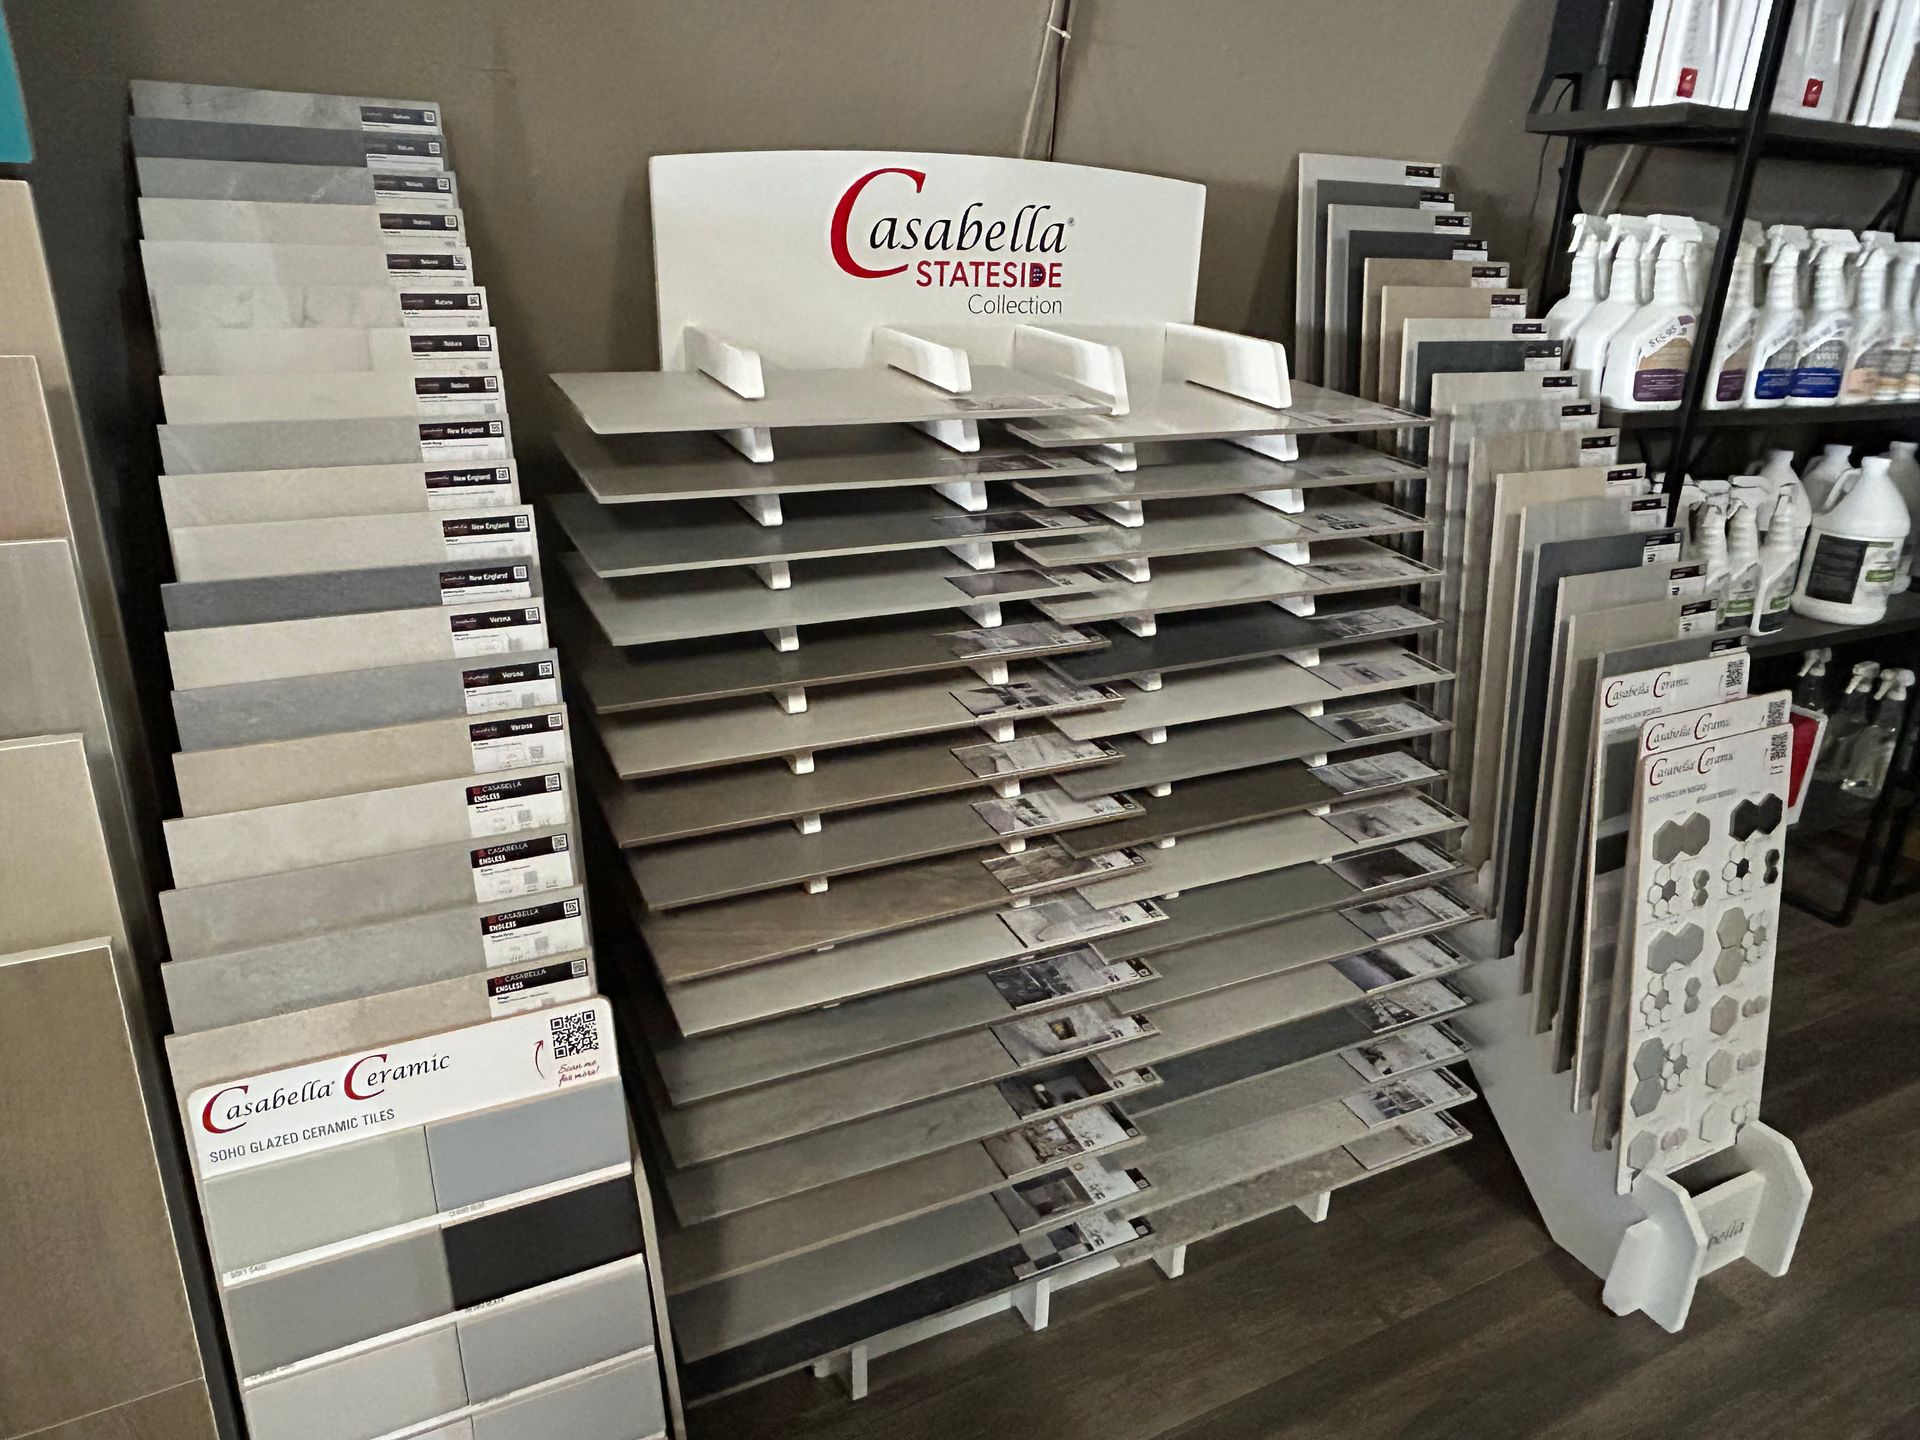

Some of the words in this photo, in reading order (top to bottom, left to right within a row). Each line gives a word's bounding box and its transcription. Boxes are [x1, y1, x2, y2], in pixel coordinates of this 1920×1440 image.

[830, 167, 1067, 279] Casabella
[916, 260, 1062, 289] STATESIDE
[968, 293, 1062, 315] Collection
[447, 427, 460, 435] New
[461, 426, 484, 436] England
[485, 521, 510, 531] England
[501, 670, 524, 679] Verona
[482, 781, 522, 793] CASABELLA
[474, 792, 501, 803] ENDLESS
[487, 843, 528, 855] CASABELLA
[479, 854, 506, 865] ENDLESS
[498, 908, 539, 921] CASABELLA
[489, 920, 517, 932] ENDLESS
[504, 968, 547, 982] CASABELLA
[495, 981, 524, 993] ENDLESS
[202, 1079, 334, 1133] Casabella
[343, 1053, 450, 1100] Ceramic
[209, 1144, 246, 1163] SOHO
[250, 1132, 299, 1154] GLAZED
[302, 1117, 359, 1140] CERAMIC
[362, 1108, 395, 1127] TILES
